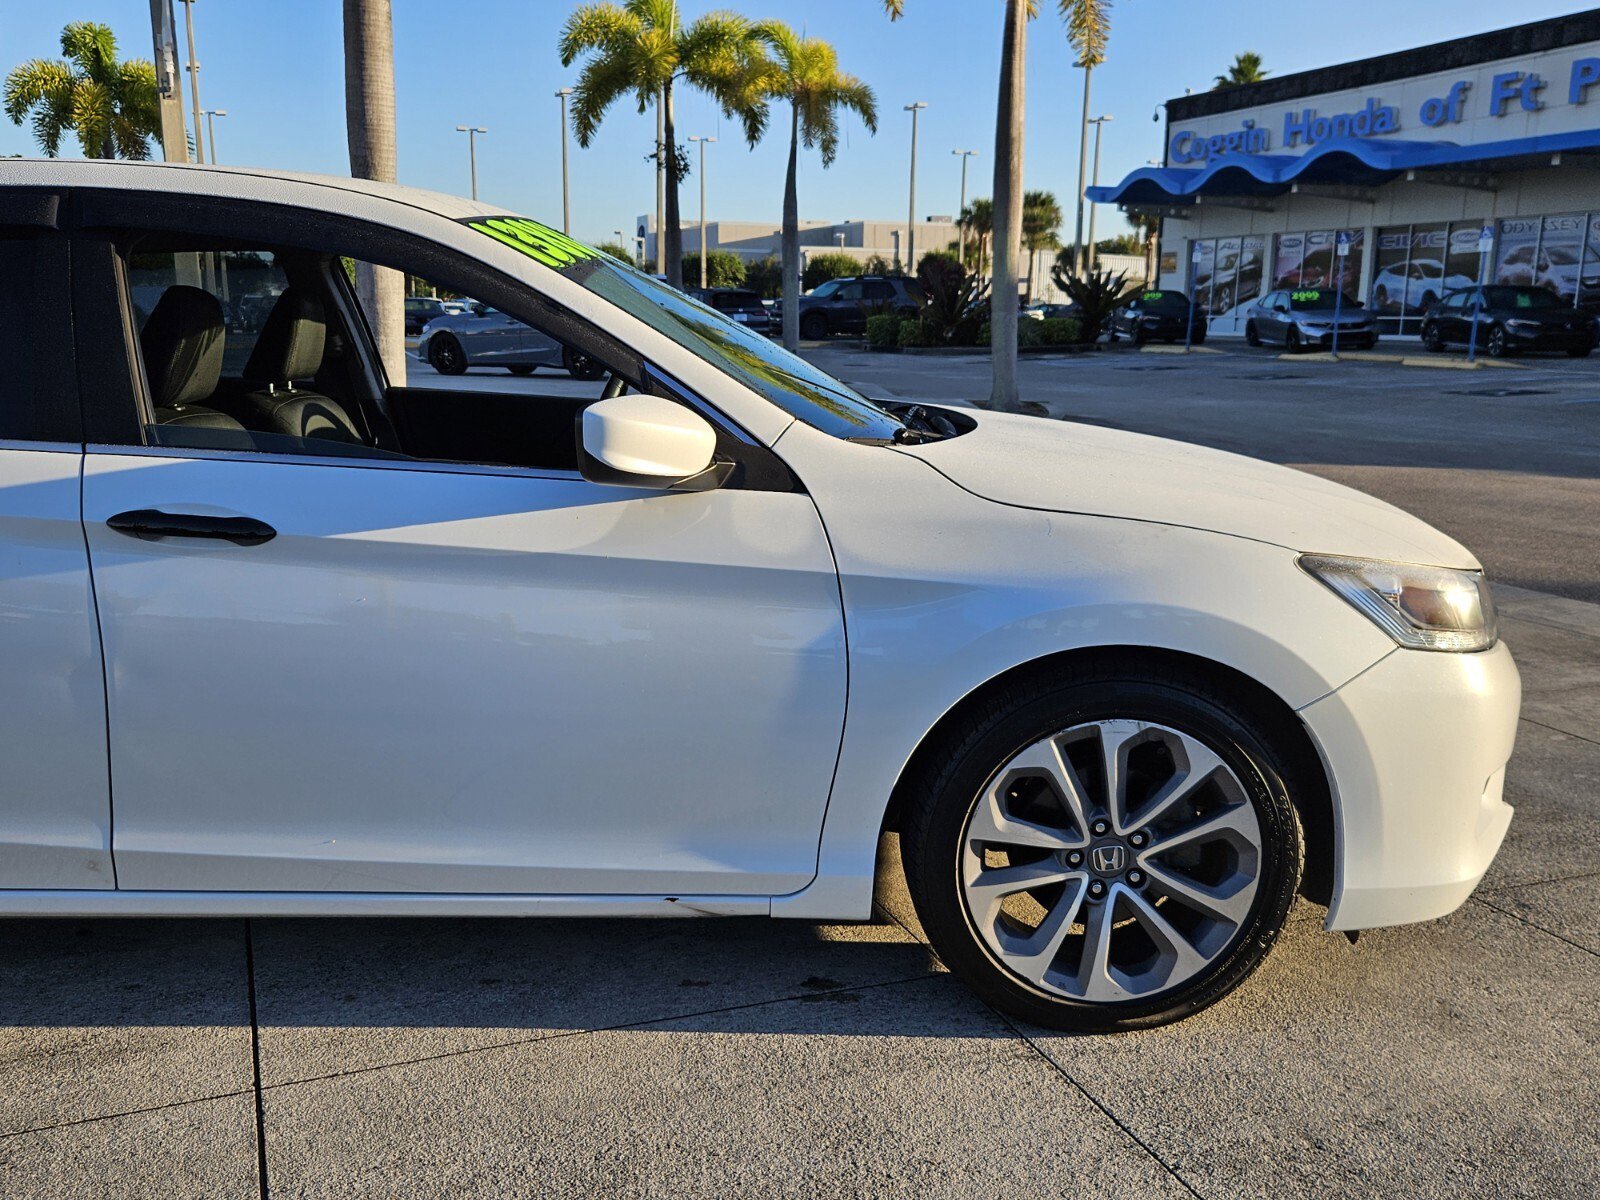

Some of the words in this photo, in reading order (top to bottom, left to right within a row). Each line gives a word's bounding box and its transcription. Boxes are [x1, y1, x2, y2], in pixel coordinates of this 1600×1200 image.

[1171, 119, 1267, 164] Coggin
[1283, 98, 1396, 147] Honda
[1420, 80, 1469, 127] of
[1490, 71, 1543, 112] Ft
